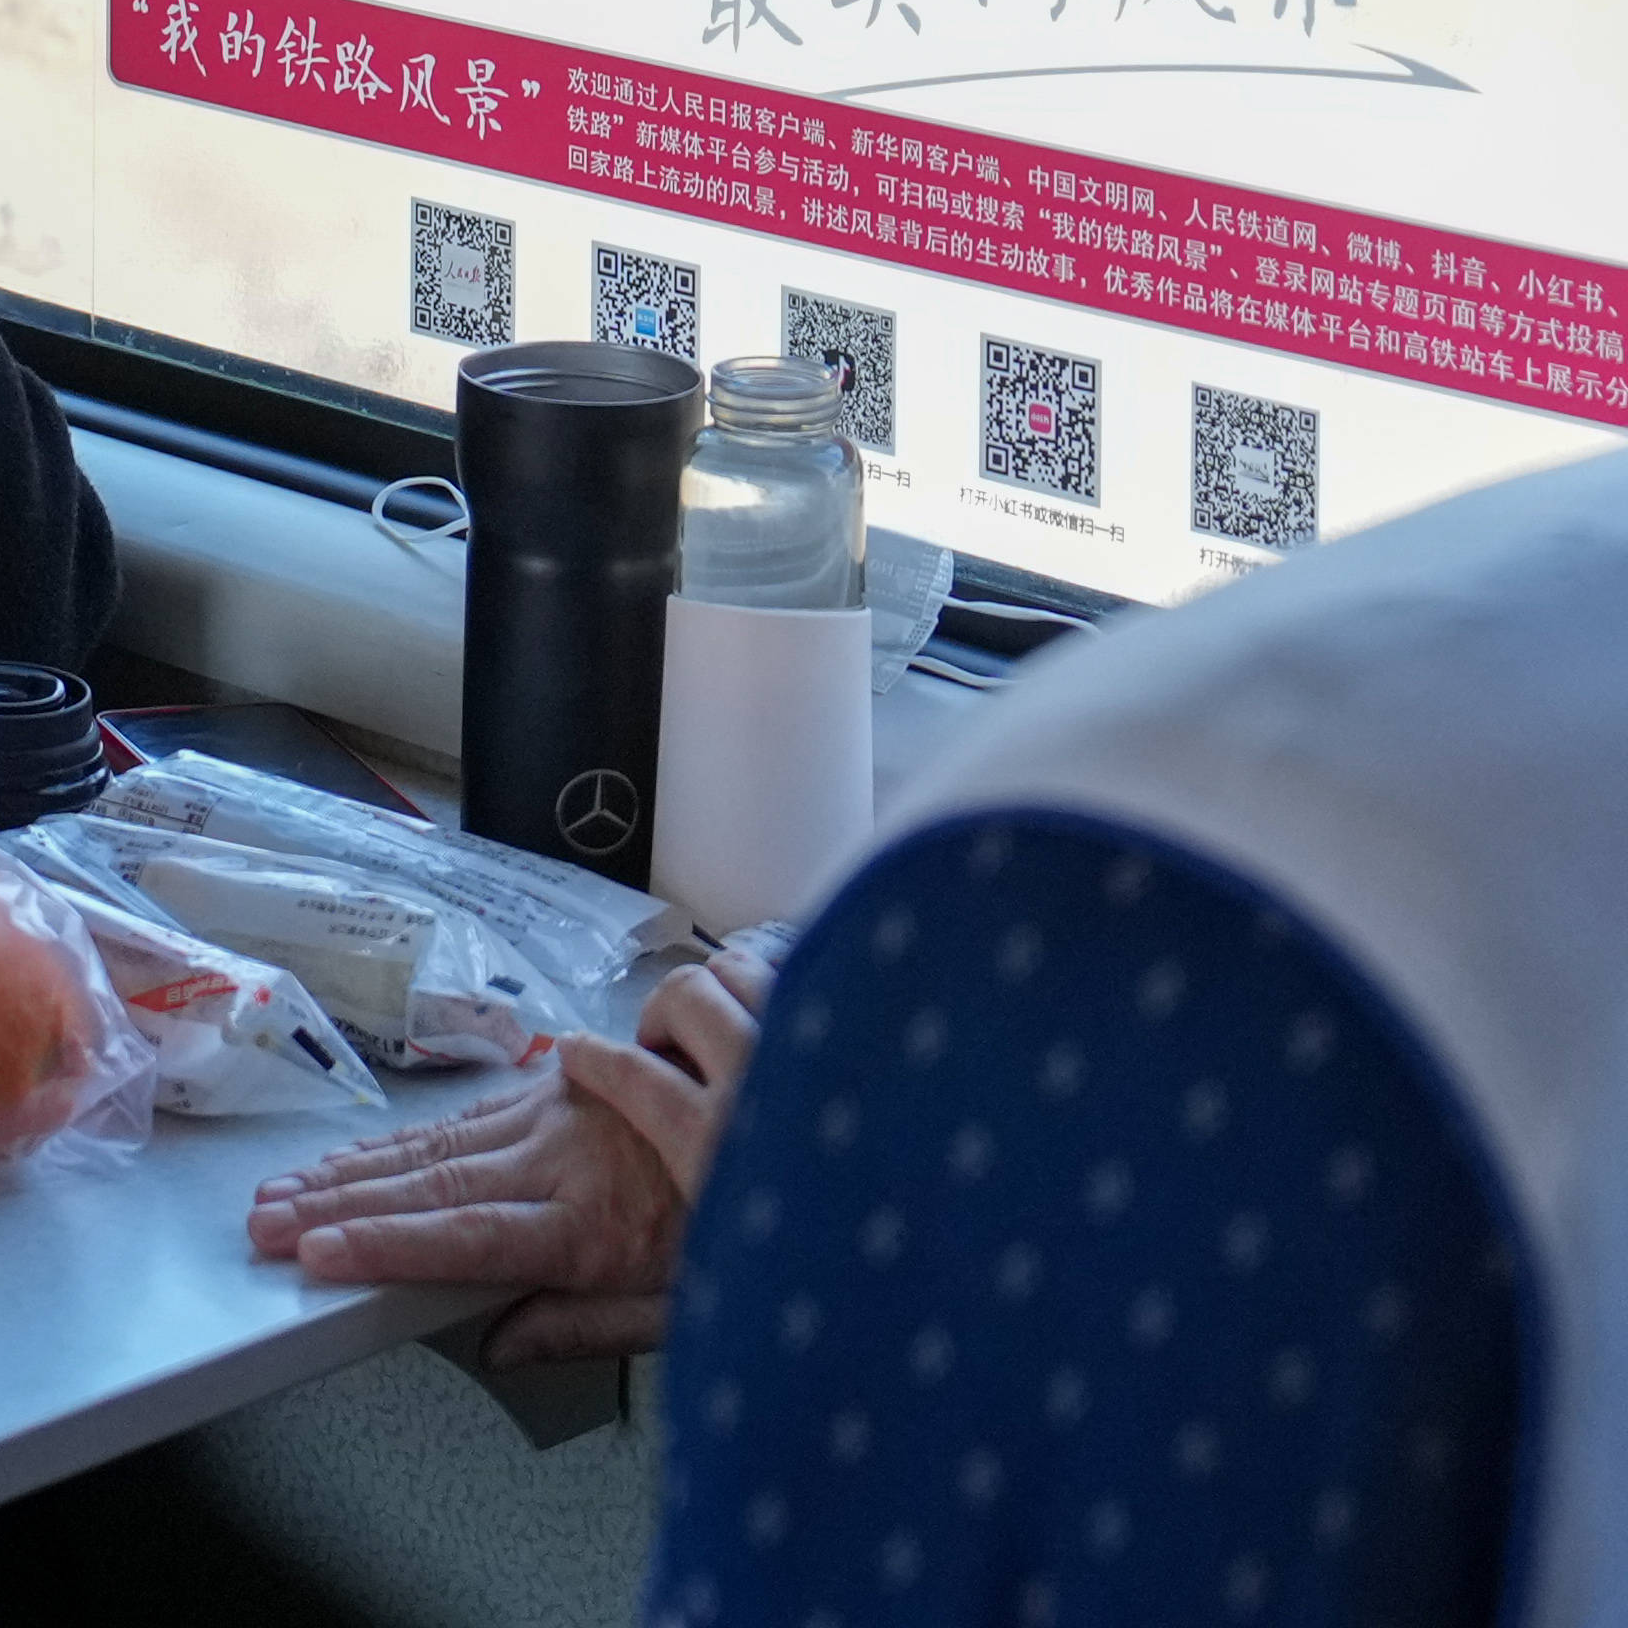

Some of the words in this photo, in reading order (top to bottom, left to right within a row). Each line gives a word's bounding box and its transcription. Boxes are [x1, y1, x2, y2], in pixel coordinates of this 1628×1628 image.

[864, 460, 911, 489] 扫一扫
[960, 487, 1125, 544] 打开小红书或微信扫一扫
